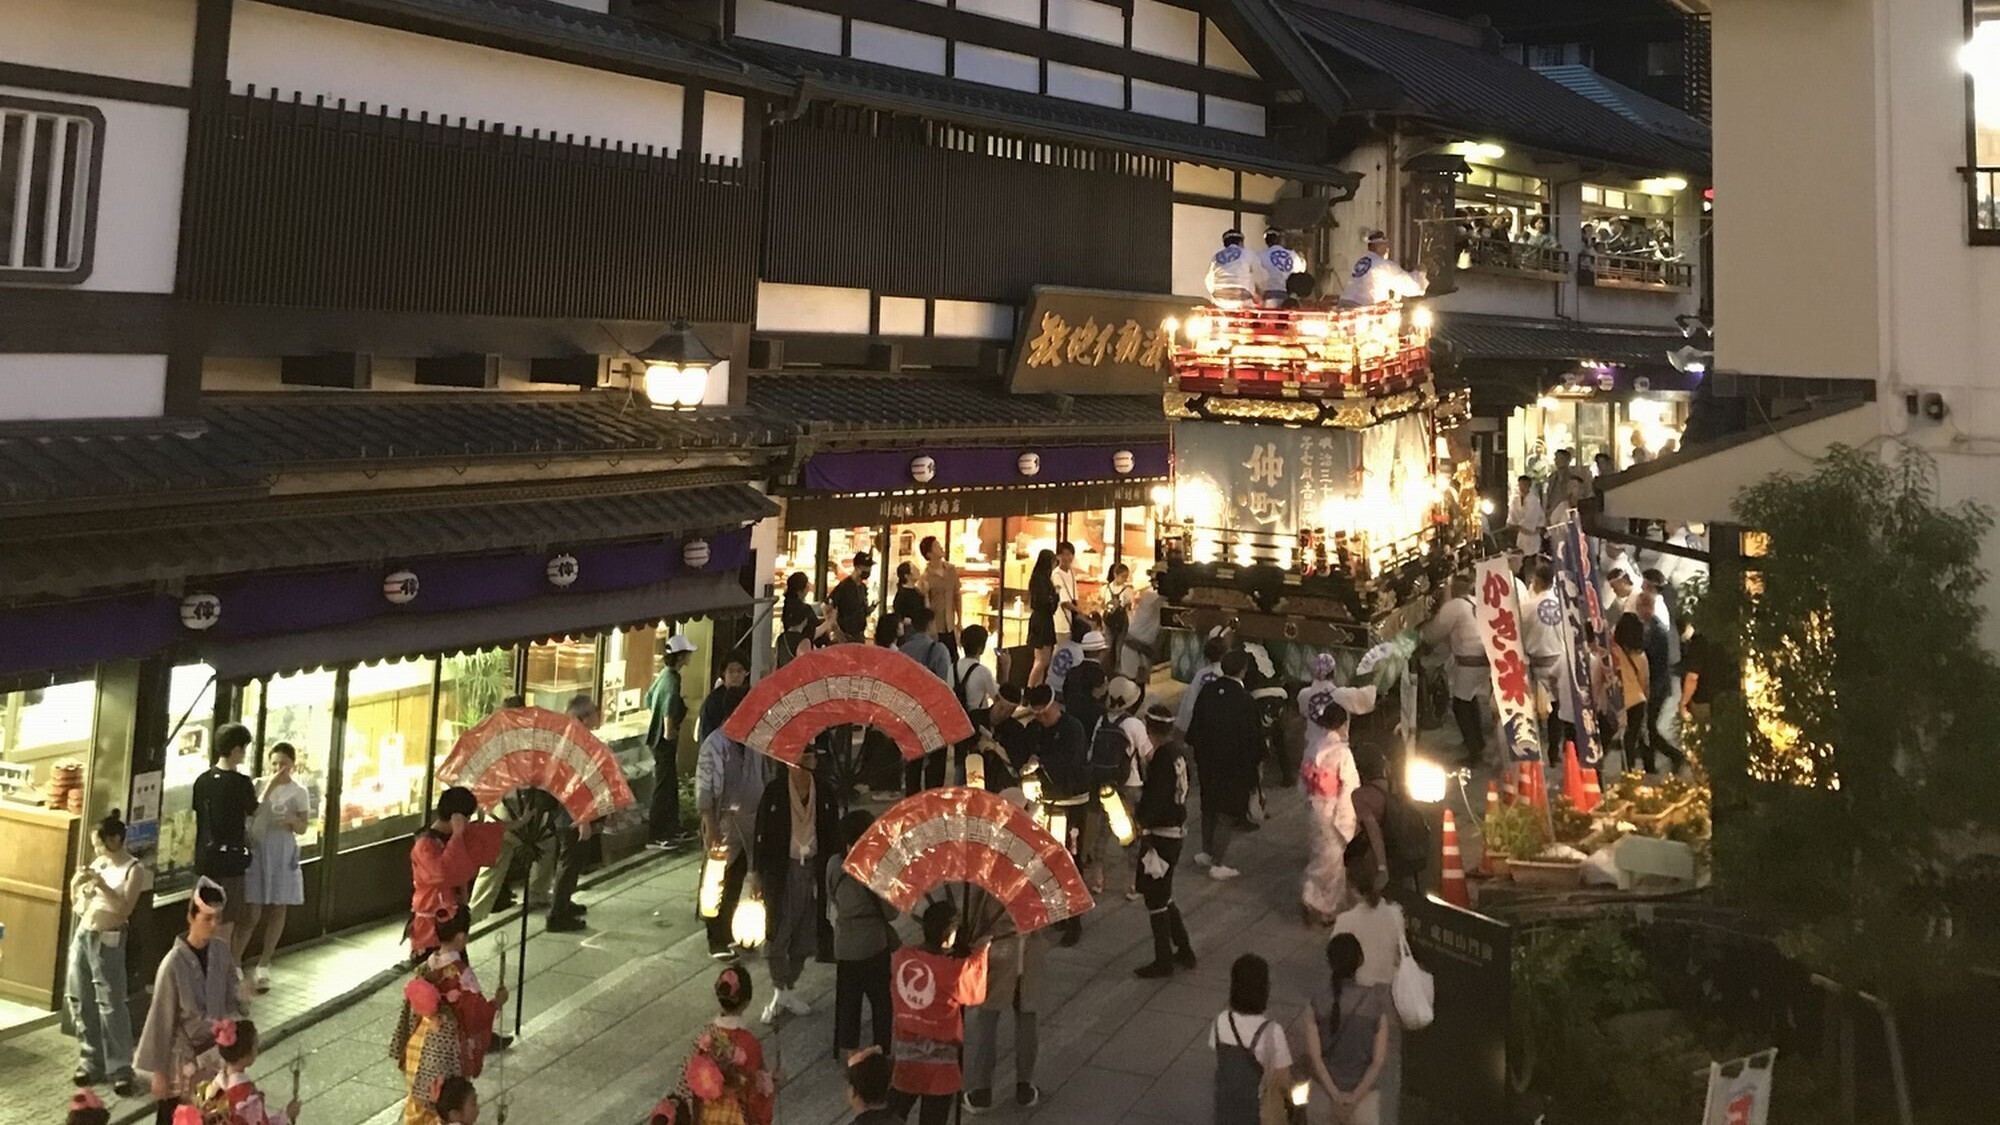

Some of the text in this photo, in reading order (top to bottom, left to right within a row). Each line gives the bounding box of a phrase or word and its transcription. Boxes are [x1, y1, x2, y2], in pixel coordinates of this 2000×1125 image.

[1242, 442, 1285, 525] 仲町
[1482, 570, 1529, 707] かき氷
